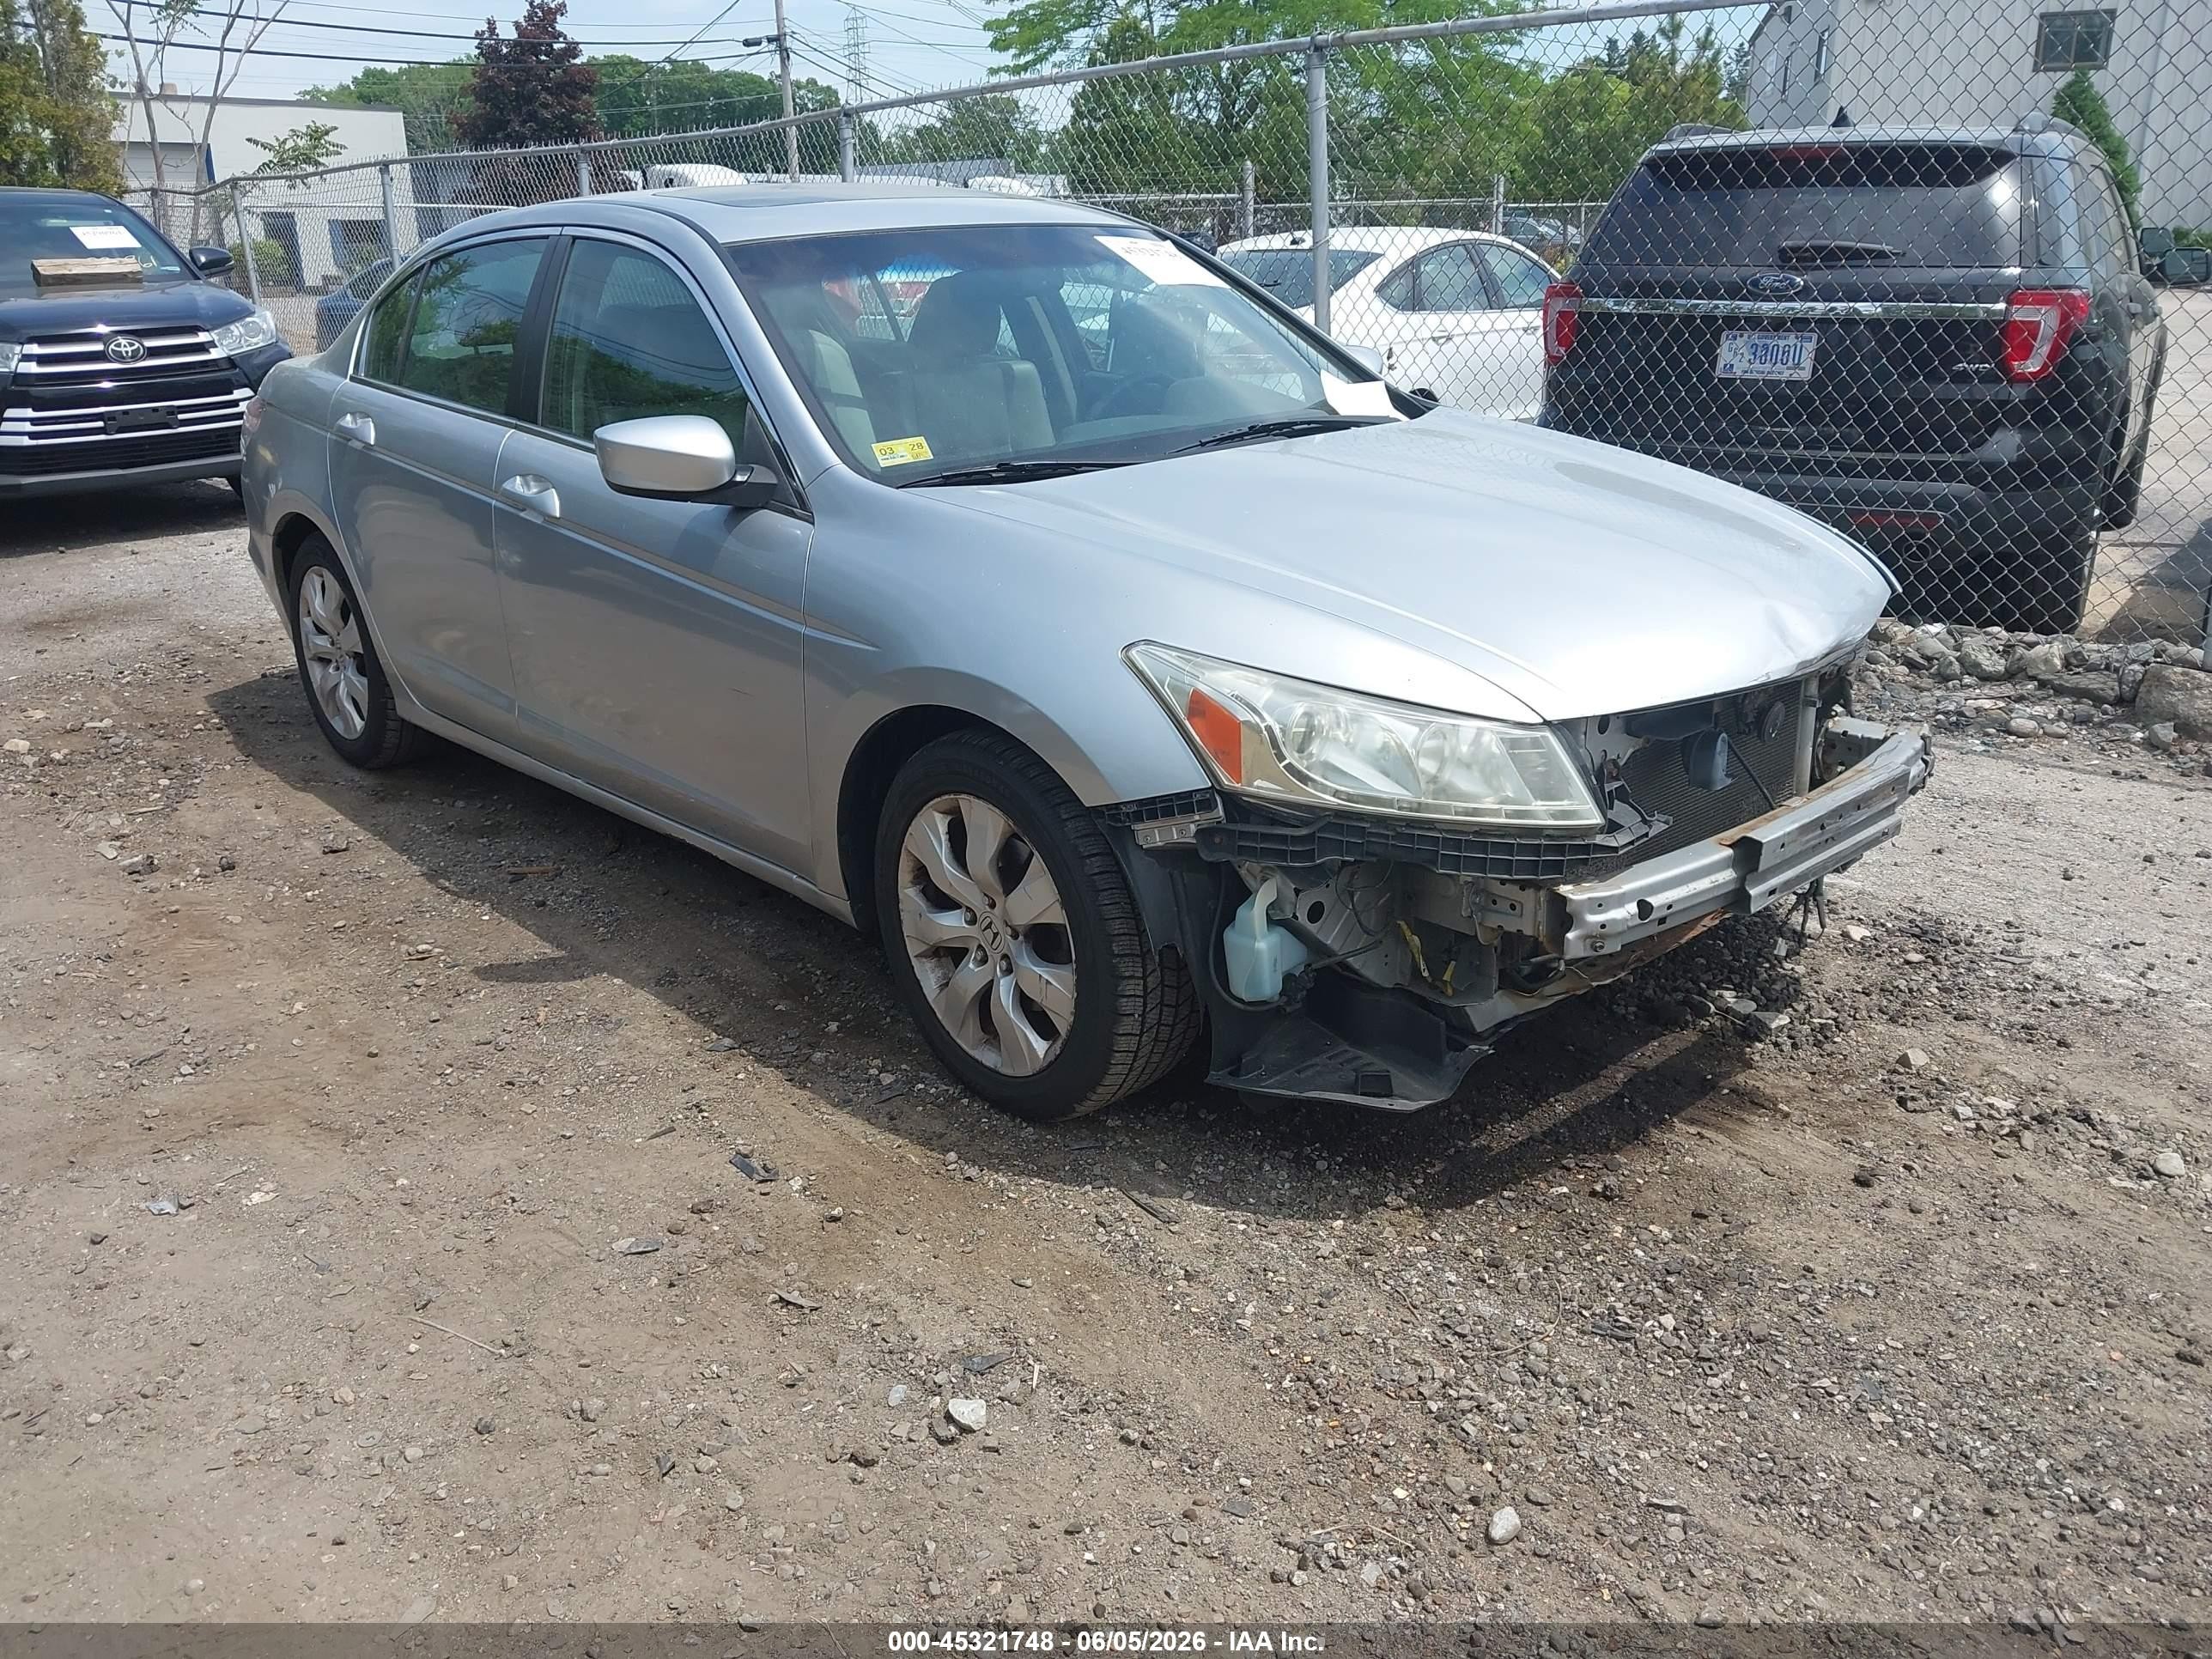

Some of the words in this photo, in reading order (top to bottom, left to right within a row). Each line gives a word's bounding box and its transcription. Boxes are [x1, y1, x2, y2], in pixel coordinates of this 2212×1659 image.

[1759, 276, 1790, 289] Ford
[908, 442, 924, 451] 28
[879, 447, 895, 456] 03
